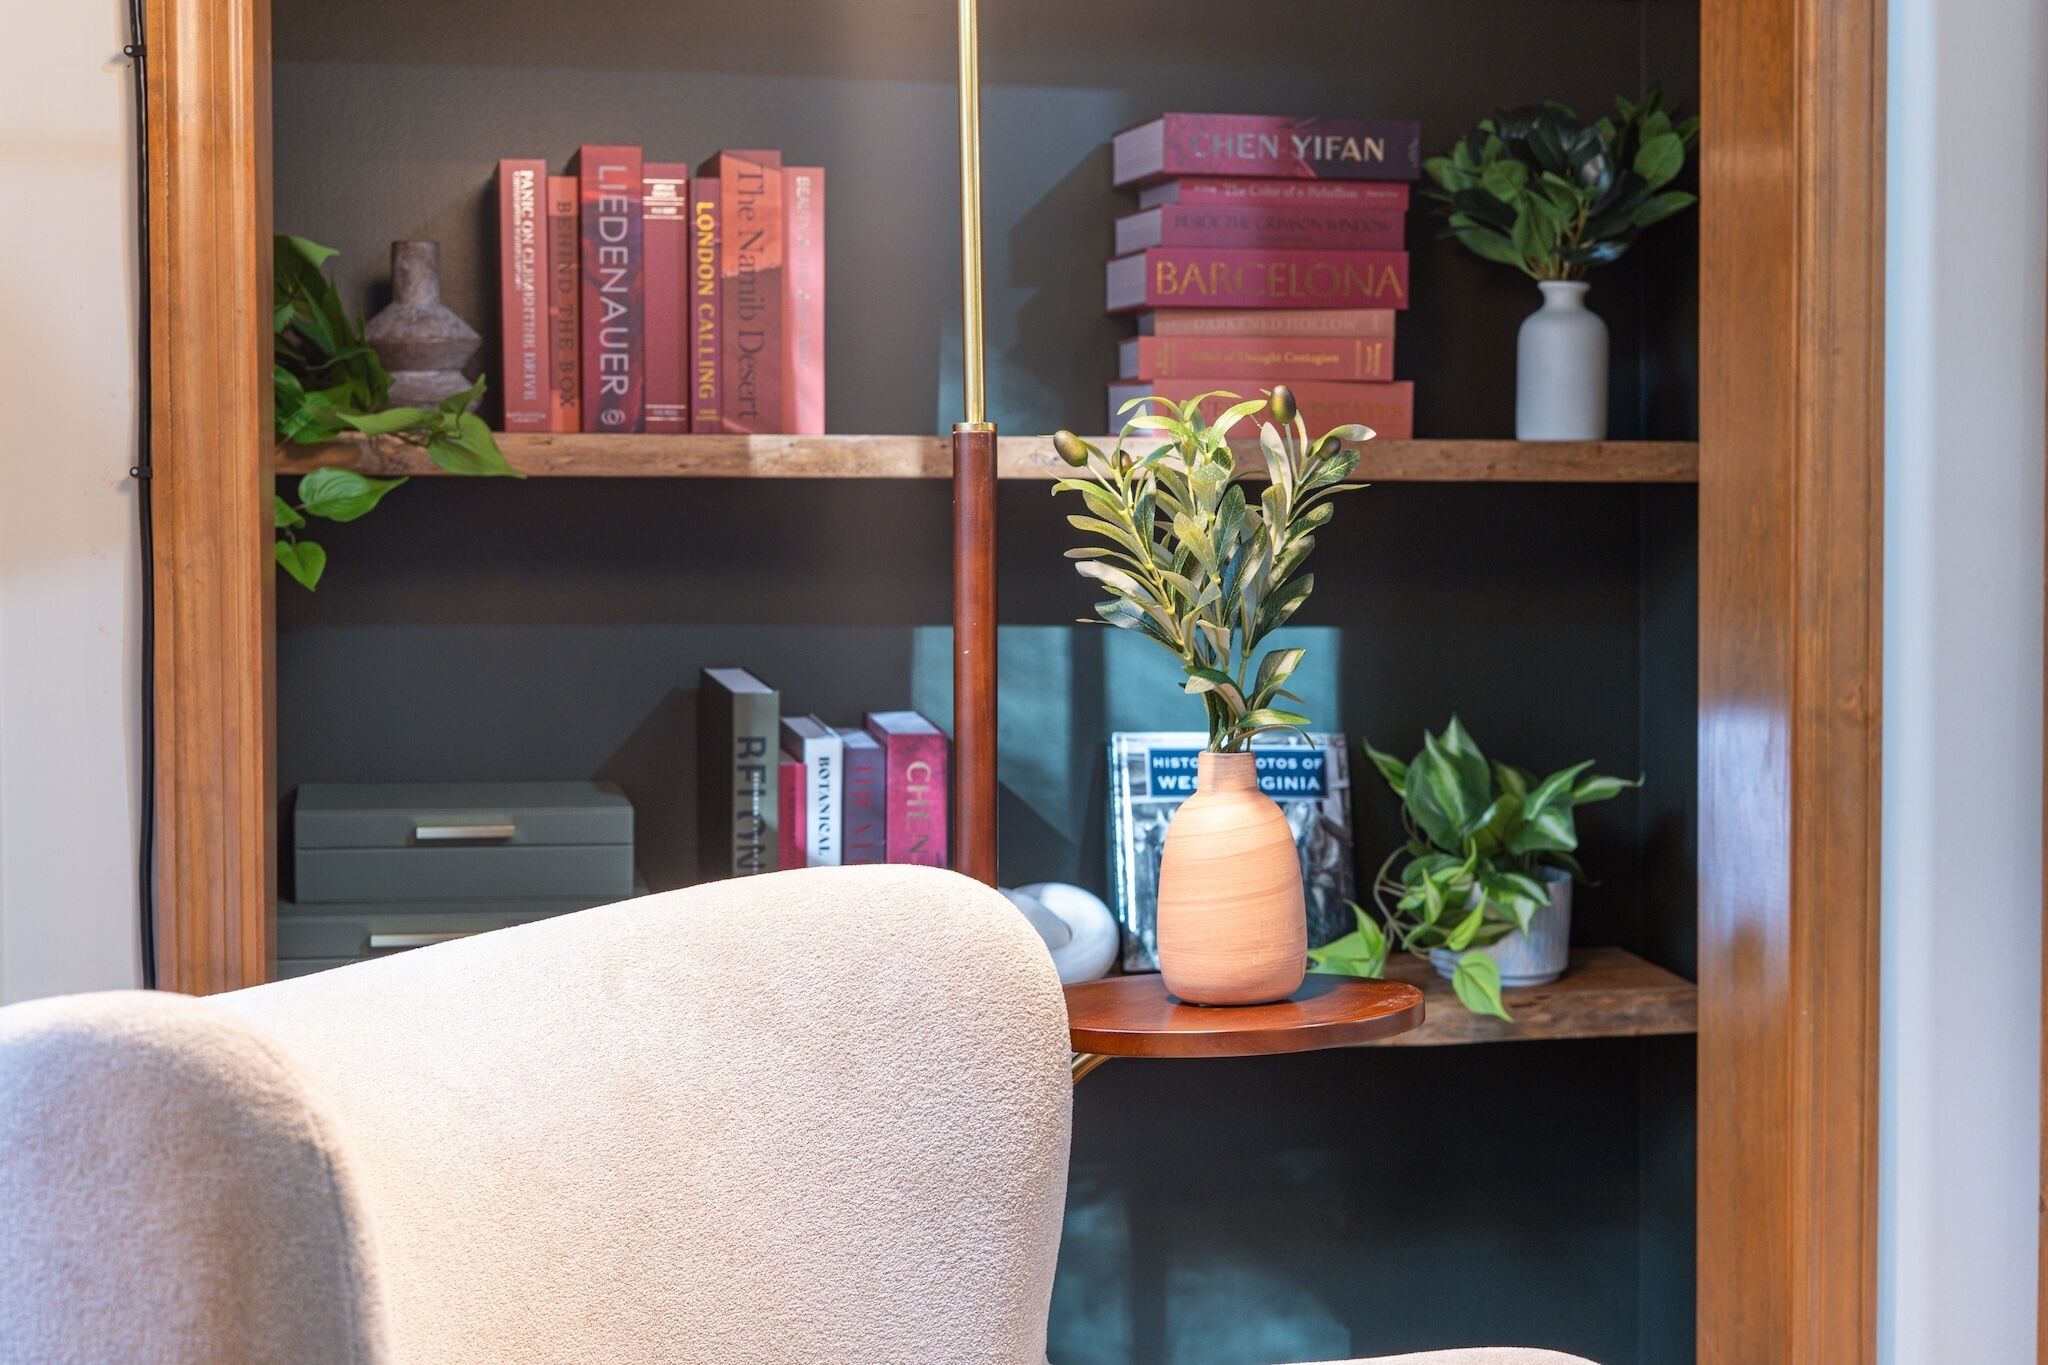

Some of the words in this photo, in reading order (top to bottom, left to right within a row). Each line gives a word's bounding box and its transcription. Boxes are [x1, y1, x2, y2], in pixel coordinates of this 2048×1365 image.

[1191, 133, 1279, 160] CHEN
[1291, 135, 1384, 162] YIFAN
[520, 169, 535, 218] PANIC
[737, 164, 764, 222] The
[521, 220, 535, 243] ON
[556, 201, 573, 293] BEHIND
[696, 202, 715, 296] LONDON
[598, 165, 629, 396] LIEDENAUER
[737, 226, 765, 321] Namib
[1156, 261, 1403, 298] BARCELONA
[558, 305, 574, 350] THE
[698, 304, 716, 399] CALLING
[523, 352, 536, 400] DRIVE
[559, 355, 575, 407] BOX
[737, 330, 766, 420] Desert
[1153, 756, 1198, 769] HISTO
[1255, 757, 1298, 770] OTOS
[1302, 758, 1323, 770] OF
[1157, 775, 1198, 790] WES
[1257, 775, 1321, 791] GINIA
[818, 756, 831, 855] BOTANICAL
[907, 761, 932, 857] CHEN
